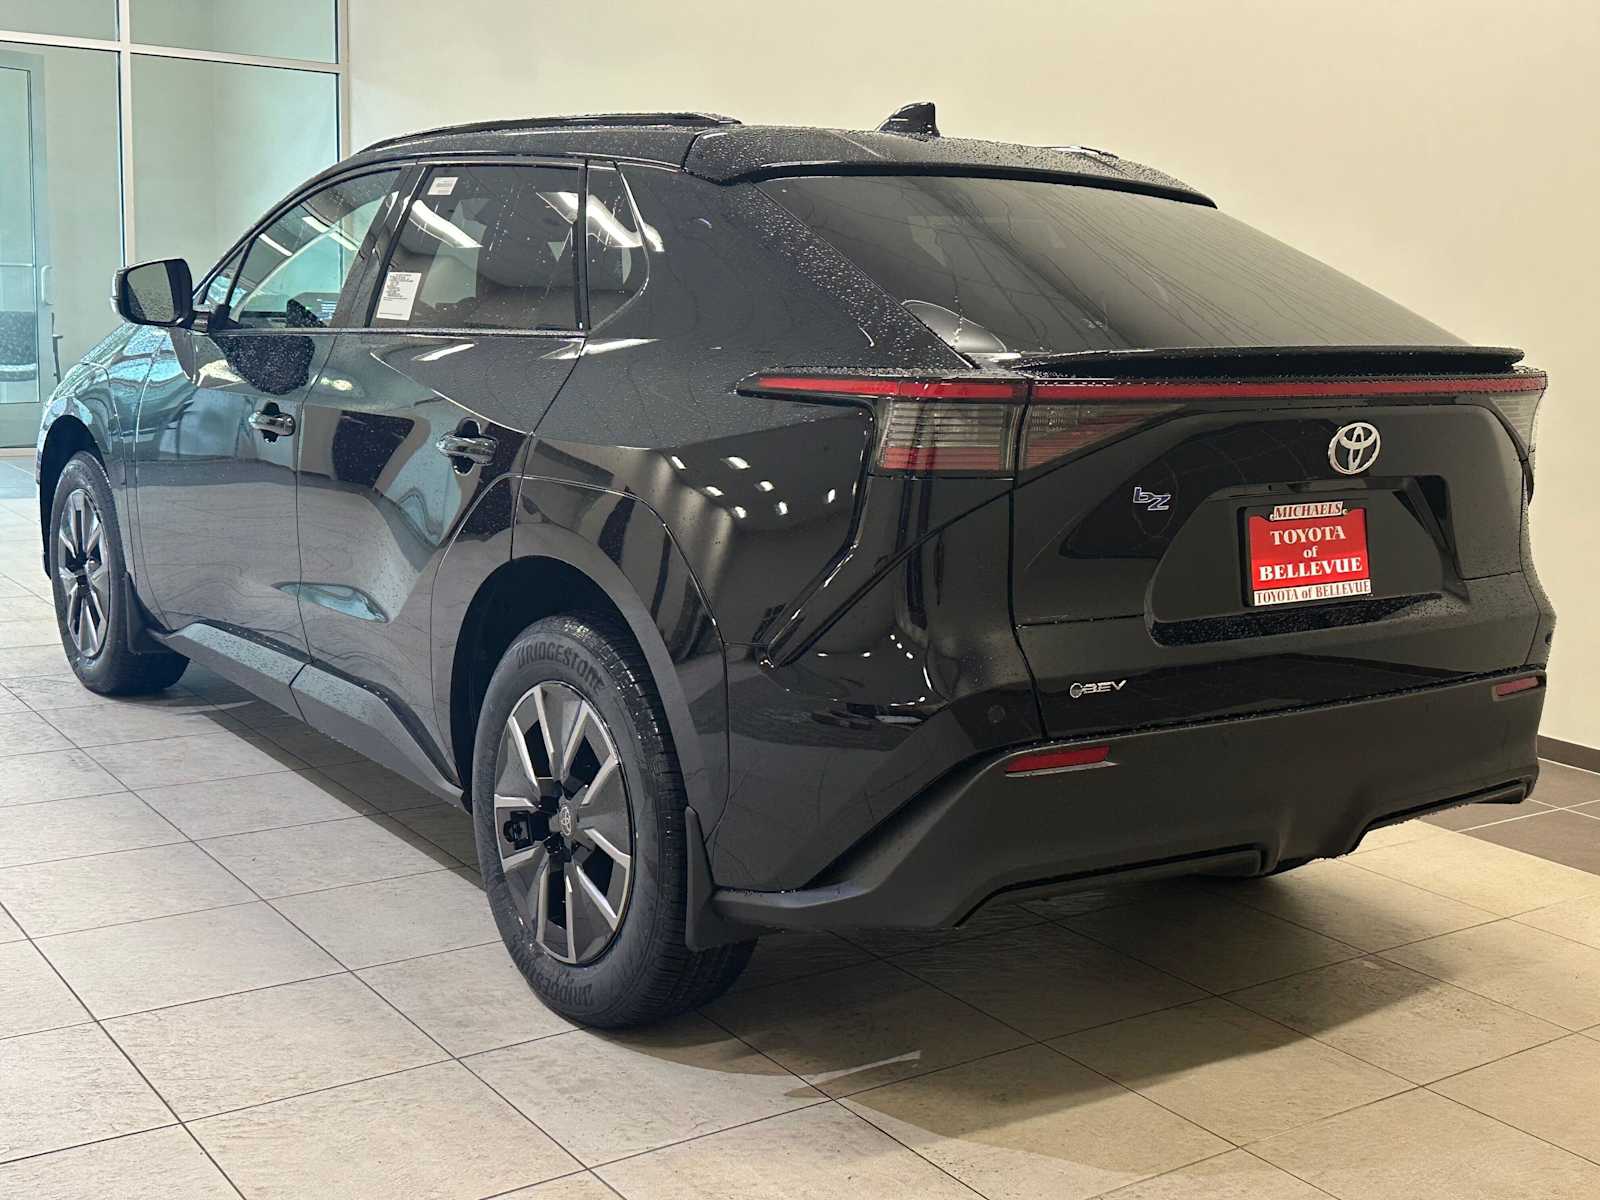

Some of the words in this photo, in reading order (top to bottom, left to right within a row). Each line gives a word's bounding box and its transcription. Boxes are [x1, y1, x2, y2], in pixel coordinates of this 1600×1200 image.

[1274, 502, 1342, 519] MICHAELS
[1270, 525, 1347, 545] TOYOTA
[1303, 545, 1318, 558] of
[1258, 556, 1363, 581] BELLEVUE
[1255, 588, 1299, 604] TOYOTA
[1301, 587, 1313, 600] of
[1315, 580, 1371, 598] BELLEVUE
[516, 640, 606, 697] BRIDGESTONE
